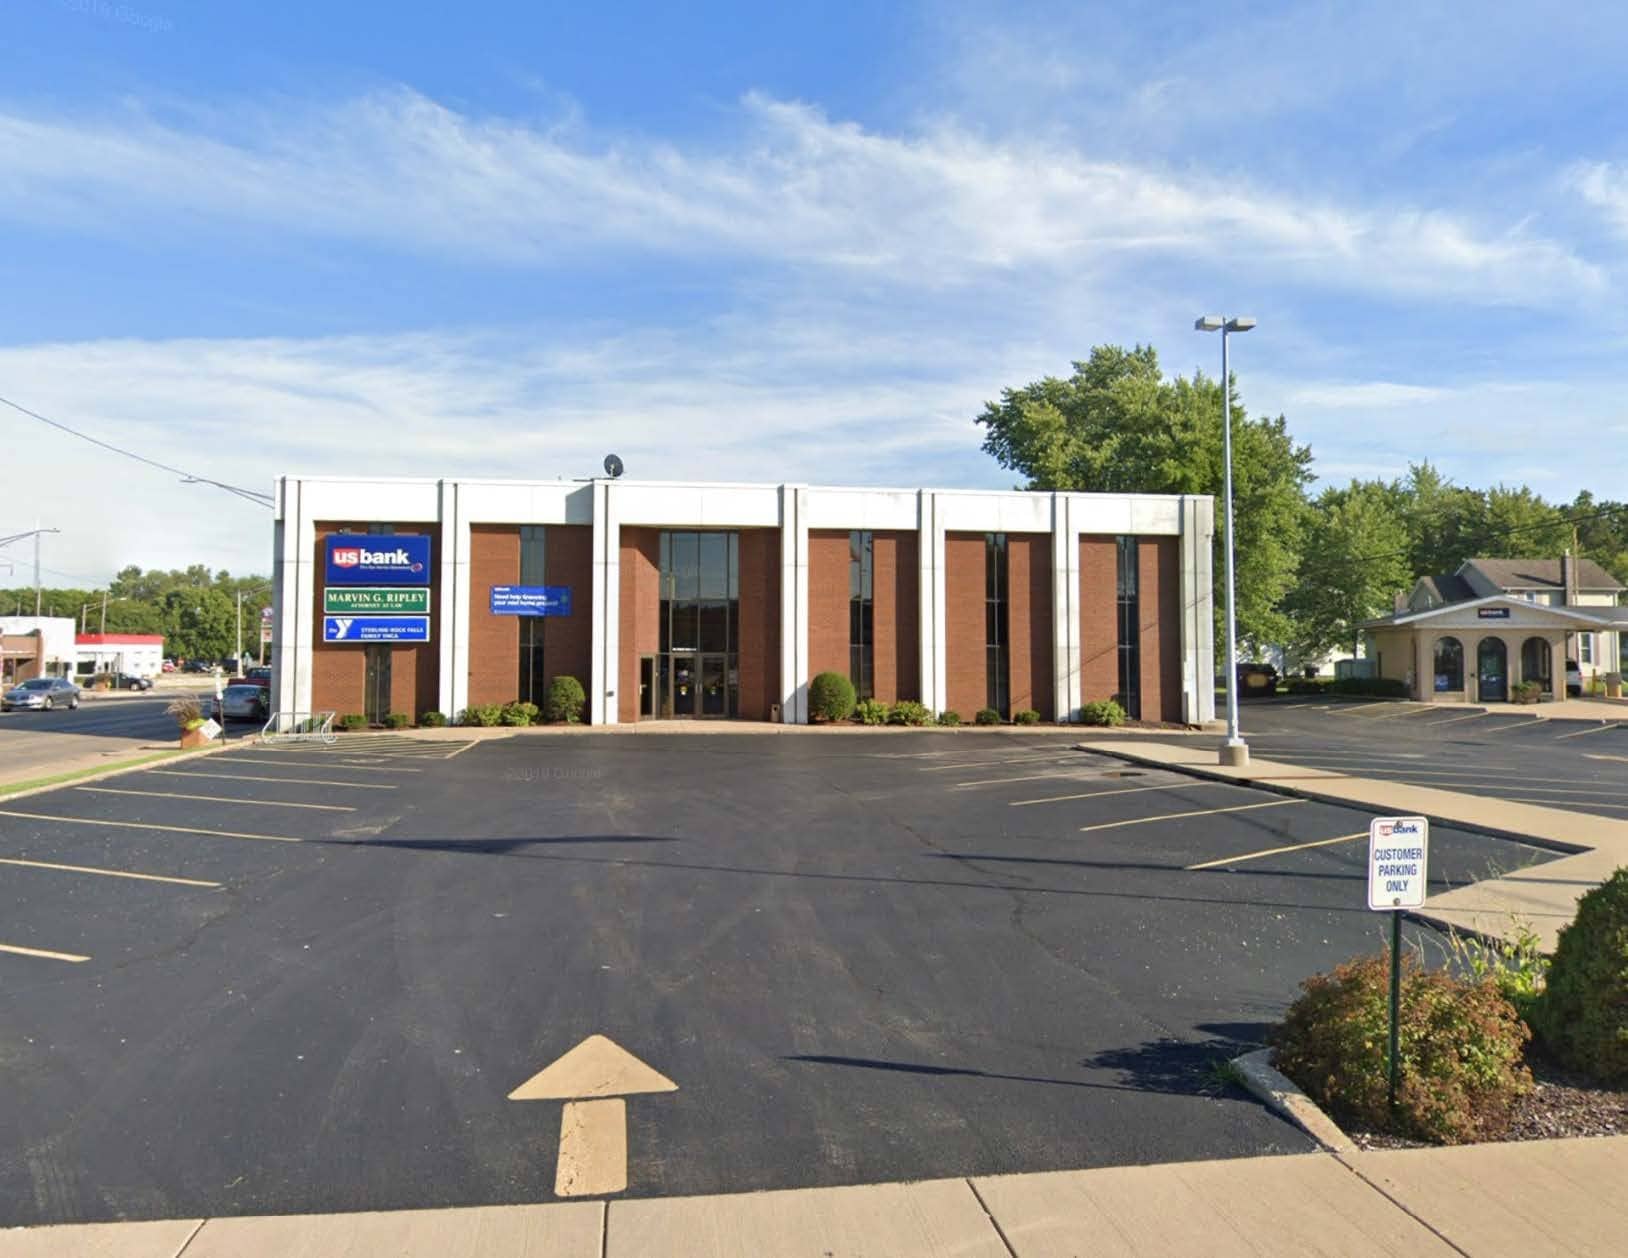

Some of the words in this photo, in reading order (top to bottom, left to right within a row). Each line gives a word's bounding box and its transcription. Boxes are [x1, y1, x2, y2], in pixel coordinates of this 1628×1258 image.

[328, 593, 370, 602] MARVIN
[387, 593, 425, 602] RIPLEY
[1374, 848, 1423, 860] CUSTOMER
[1378, 864, 1417, 876] PARKING
[1386, 880, 1408, 892] ONLY
